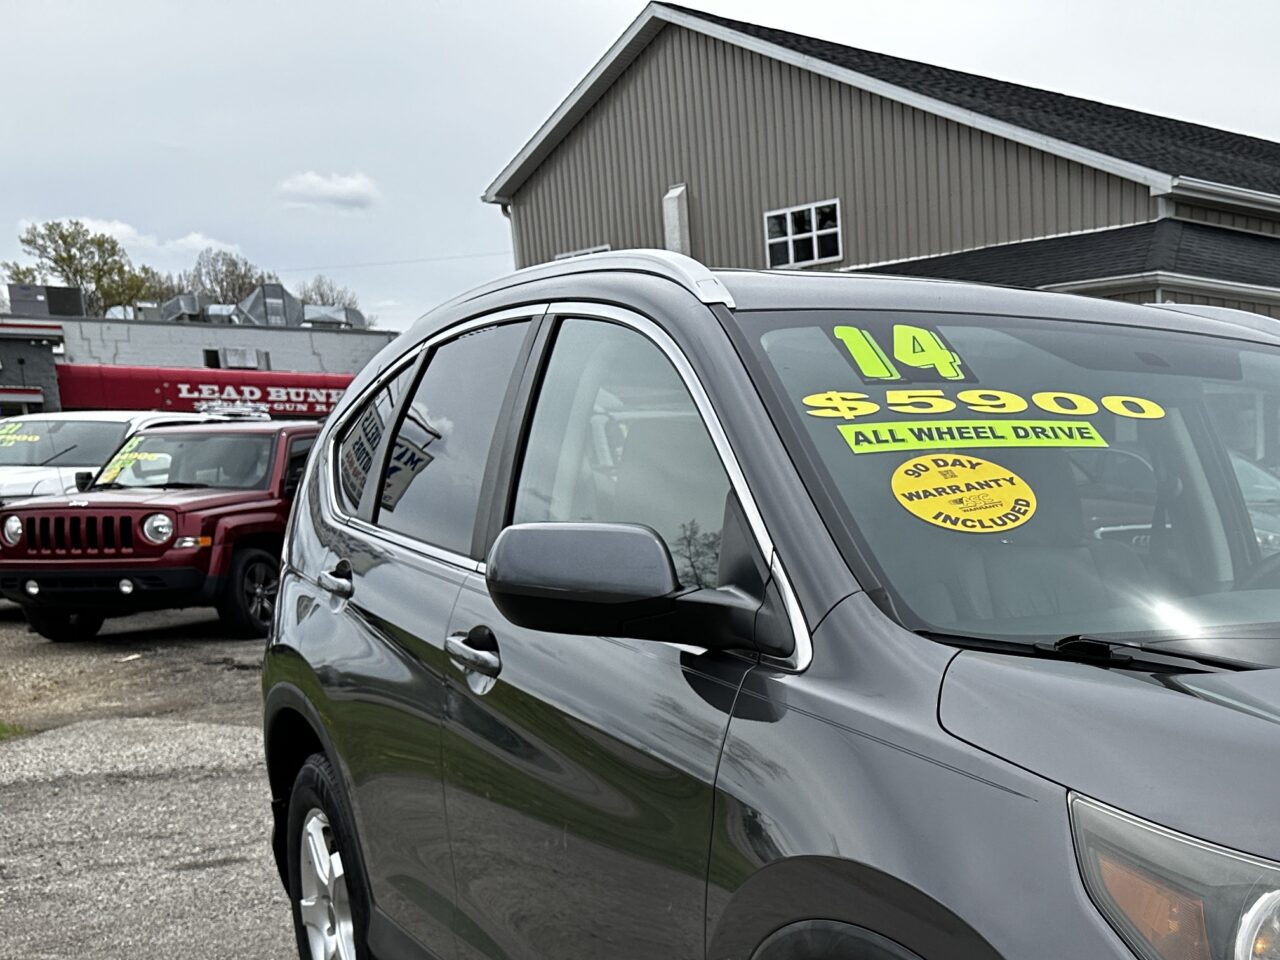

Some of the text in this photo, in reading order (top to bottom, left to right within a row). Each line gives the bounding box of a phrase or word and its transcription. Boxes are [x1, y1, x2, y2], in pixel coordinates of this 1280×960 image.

[833, 324, 965, 381] 14
[178, 384, 262, 400] LEAD
[273, 402, 308, 412] GUN
[802, 390, 1166, 420] $5900
[853, 425, 1095, 447] ALL WHEEL DRIVE
[904, 458, 983, 478] 90 DAY
[900, 476, 1016, 502] WARRANTY
[932, 498, 1031, 529] INCLUDED
